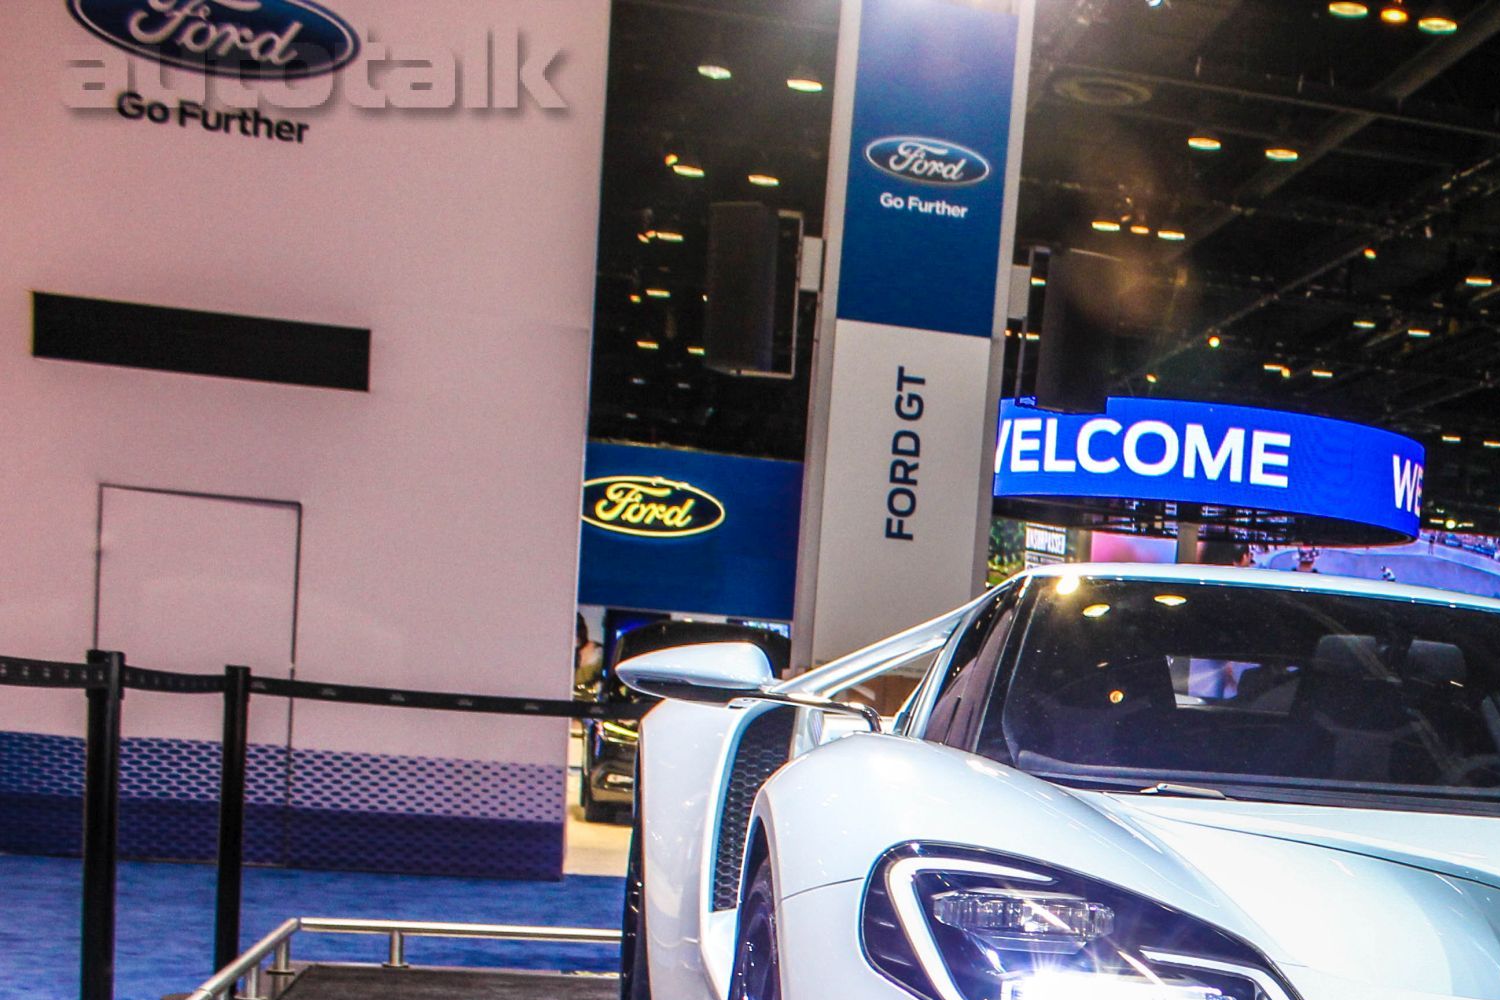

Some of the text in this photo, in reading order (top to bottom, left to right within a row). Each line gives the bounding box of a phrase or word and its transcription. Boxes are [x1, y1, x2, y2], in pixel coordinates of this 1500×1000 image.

[129, 0, 302, 64] Ford
[117, 91, 309, 143] Go Further
[889, 141, 967, 180] Ford
[879, 192, 969, 218] Go Further
[885, 365, 926, 541] FORD GT
[595, 482, 696, 528] Ford
